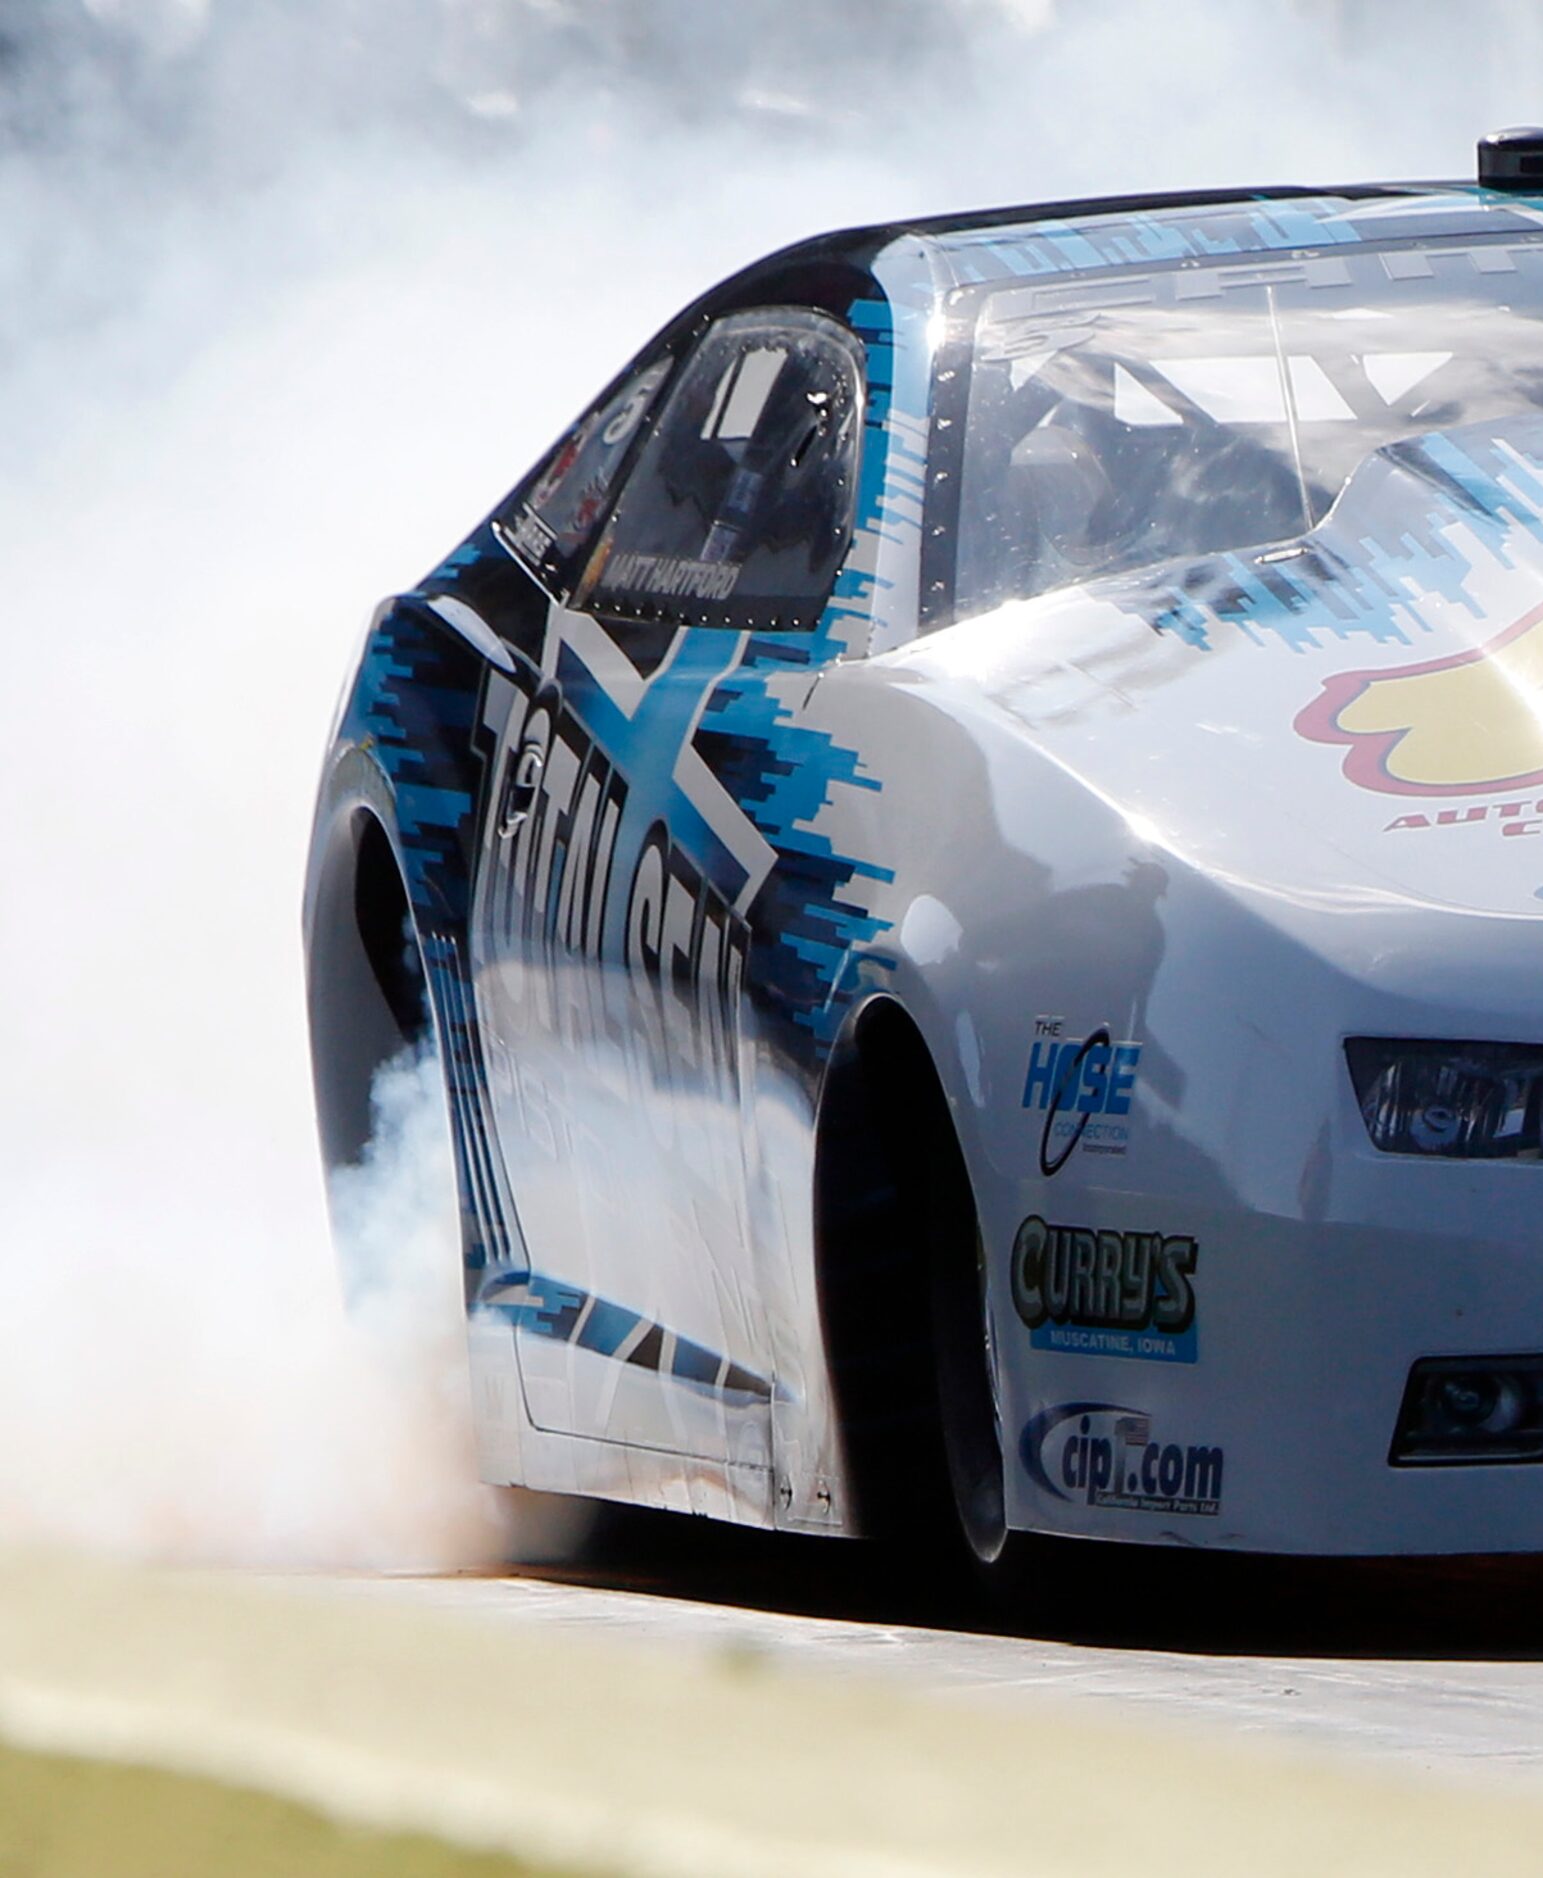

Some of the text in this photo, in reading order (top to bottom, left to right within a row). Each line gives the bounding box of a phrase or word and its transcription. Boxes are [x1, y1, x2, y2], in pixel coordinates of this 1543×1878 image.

[602, 554, 741, 600] MATT HARTFORD
[1035, 1020, 1063, 1037] THE
[1022, 1041, 1143, 1115] HOSE
[1012, 1215, 1198, 1332] CURRY'S
[1050, 1331, 1176, 1356] MUSCATINE, IOWA
